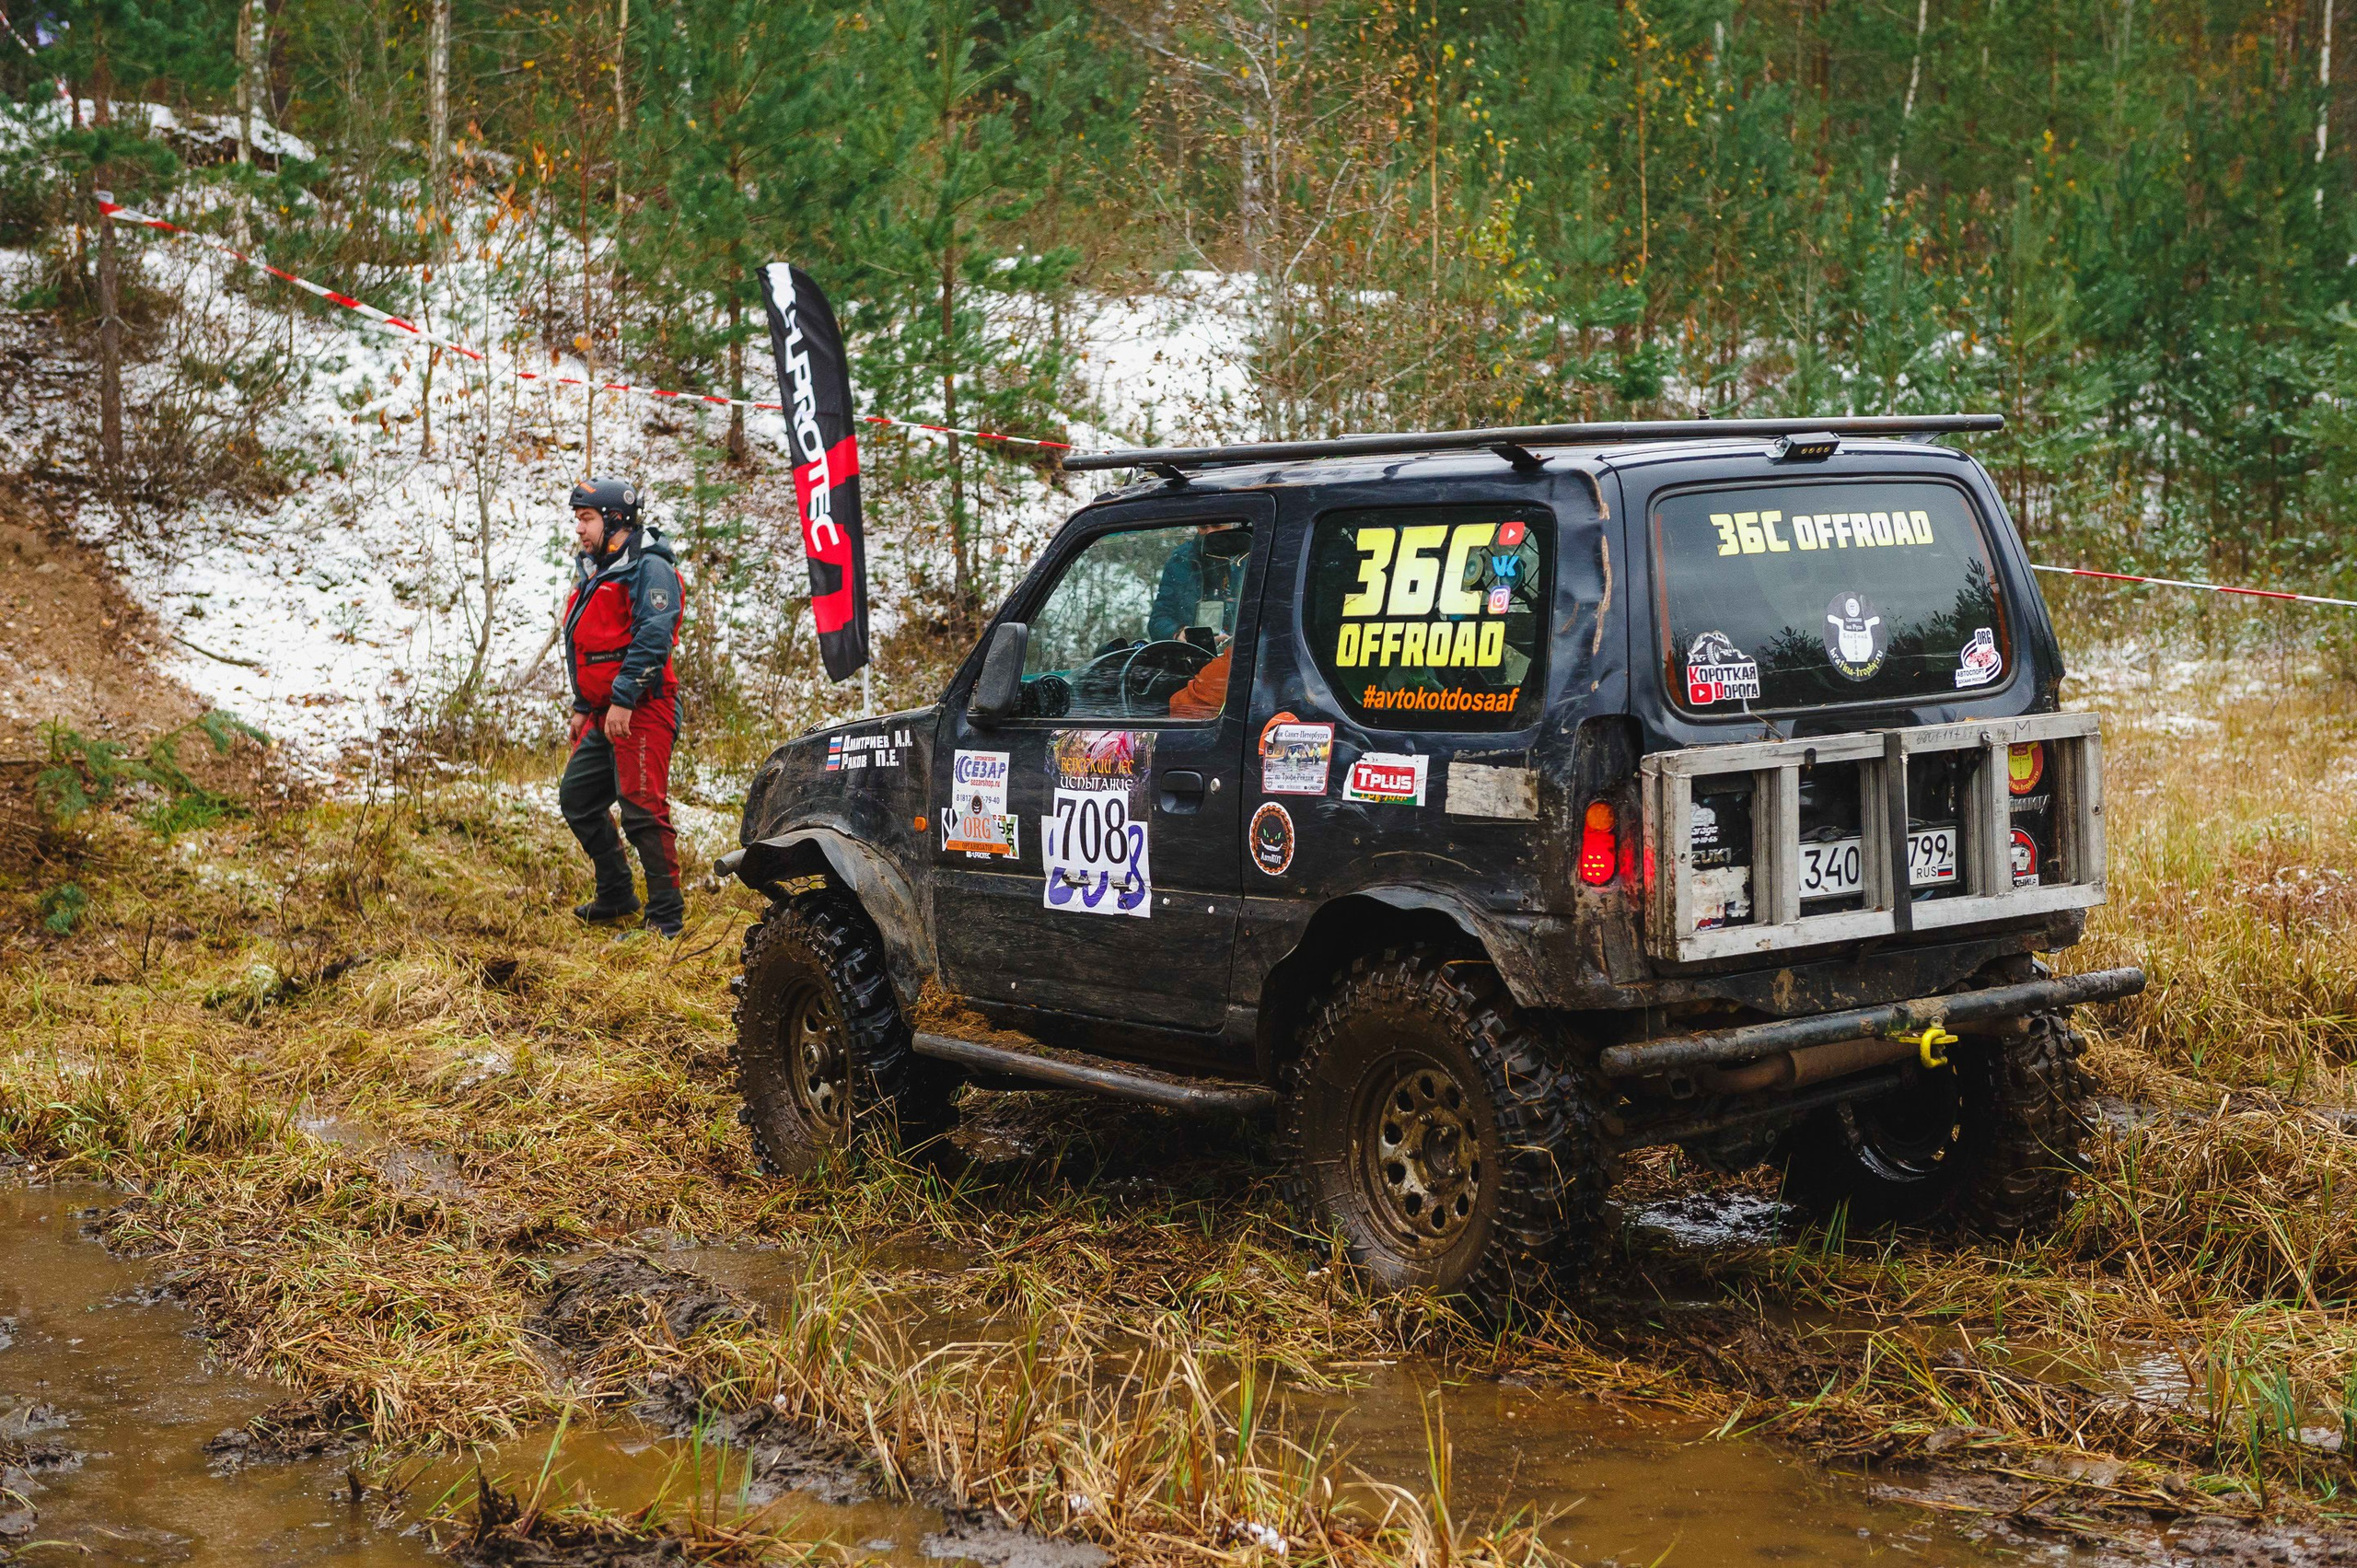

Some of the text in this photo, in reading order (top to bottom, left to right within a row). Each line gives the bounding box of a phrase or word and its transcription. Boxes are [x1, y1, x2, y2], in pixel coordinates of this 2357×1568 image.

[1792, 510, 1933, 551] OFFROAD
[1335, 621, 1506, 668] OFFROAD
[1977, 631, 1991, 645] ORG
[1363, 684, 1520, 713] #avtokotdosaaf
[894, 729, 913, 748] А.А.
[875, 749, 900, 767] П.Е.
[1357, 767, 1412, 791] TPLUS
[963, 816, 992, 840] ORG
[1058, 796, 1129, 865] 708
[1691, 826, 1719, 836] arage
[1804, 833, 1947, 889] 340 799
[1916, 865, 1937, 878] RUS
